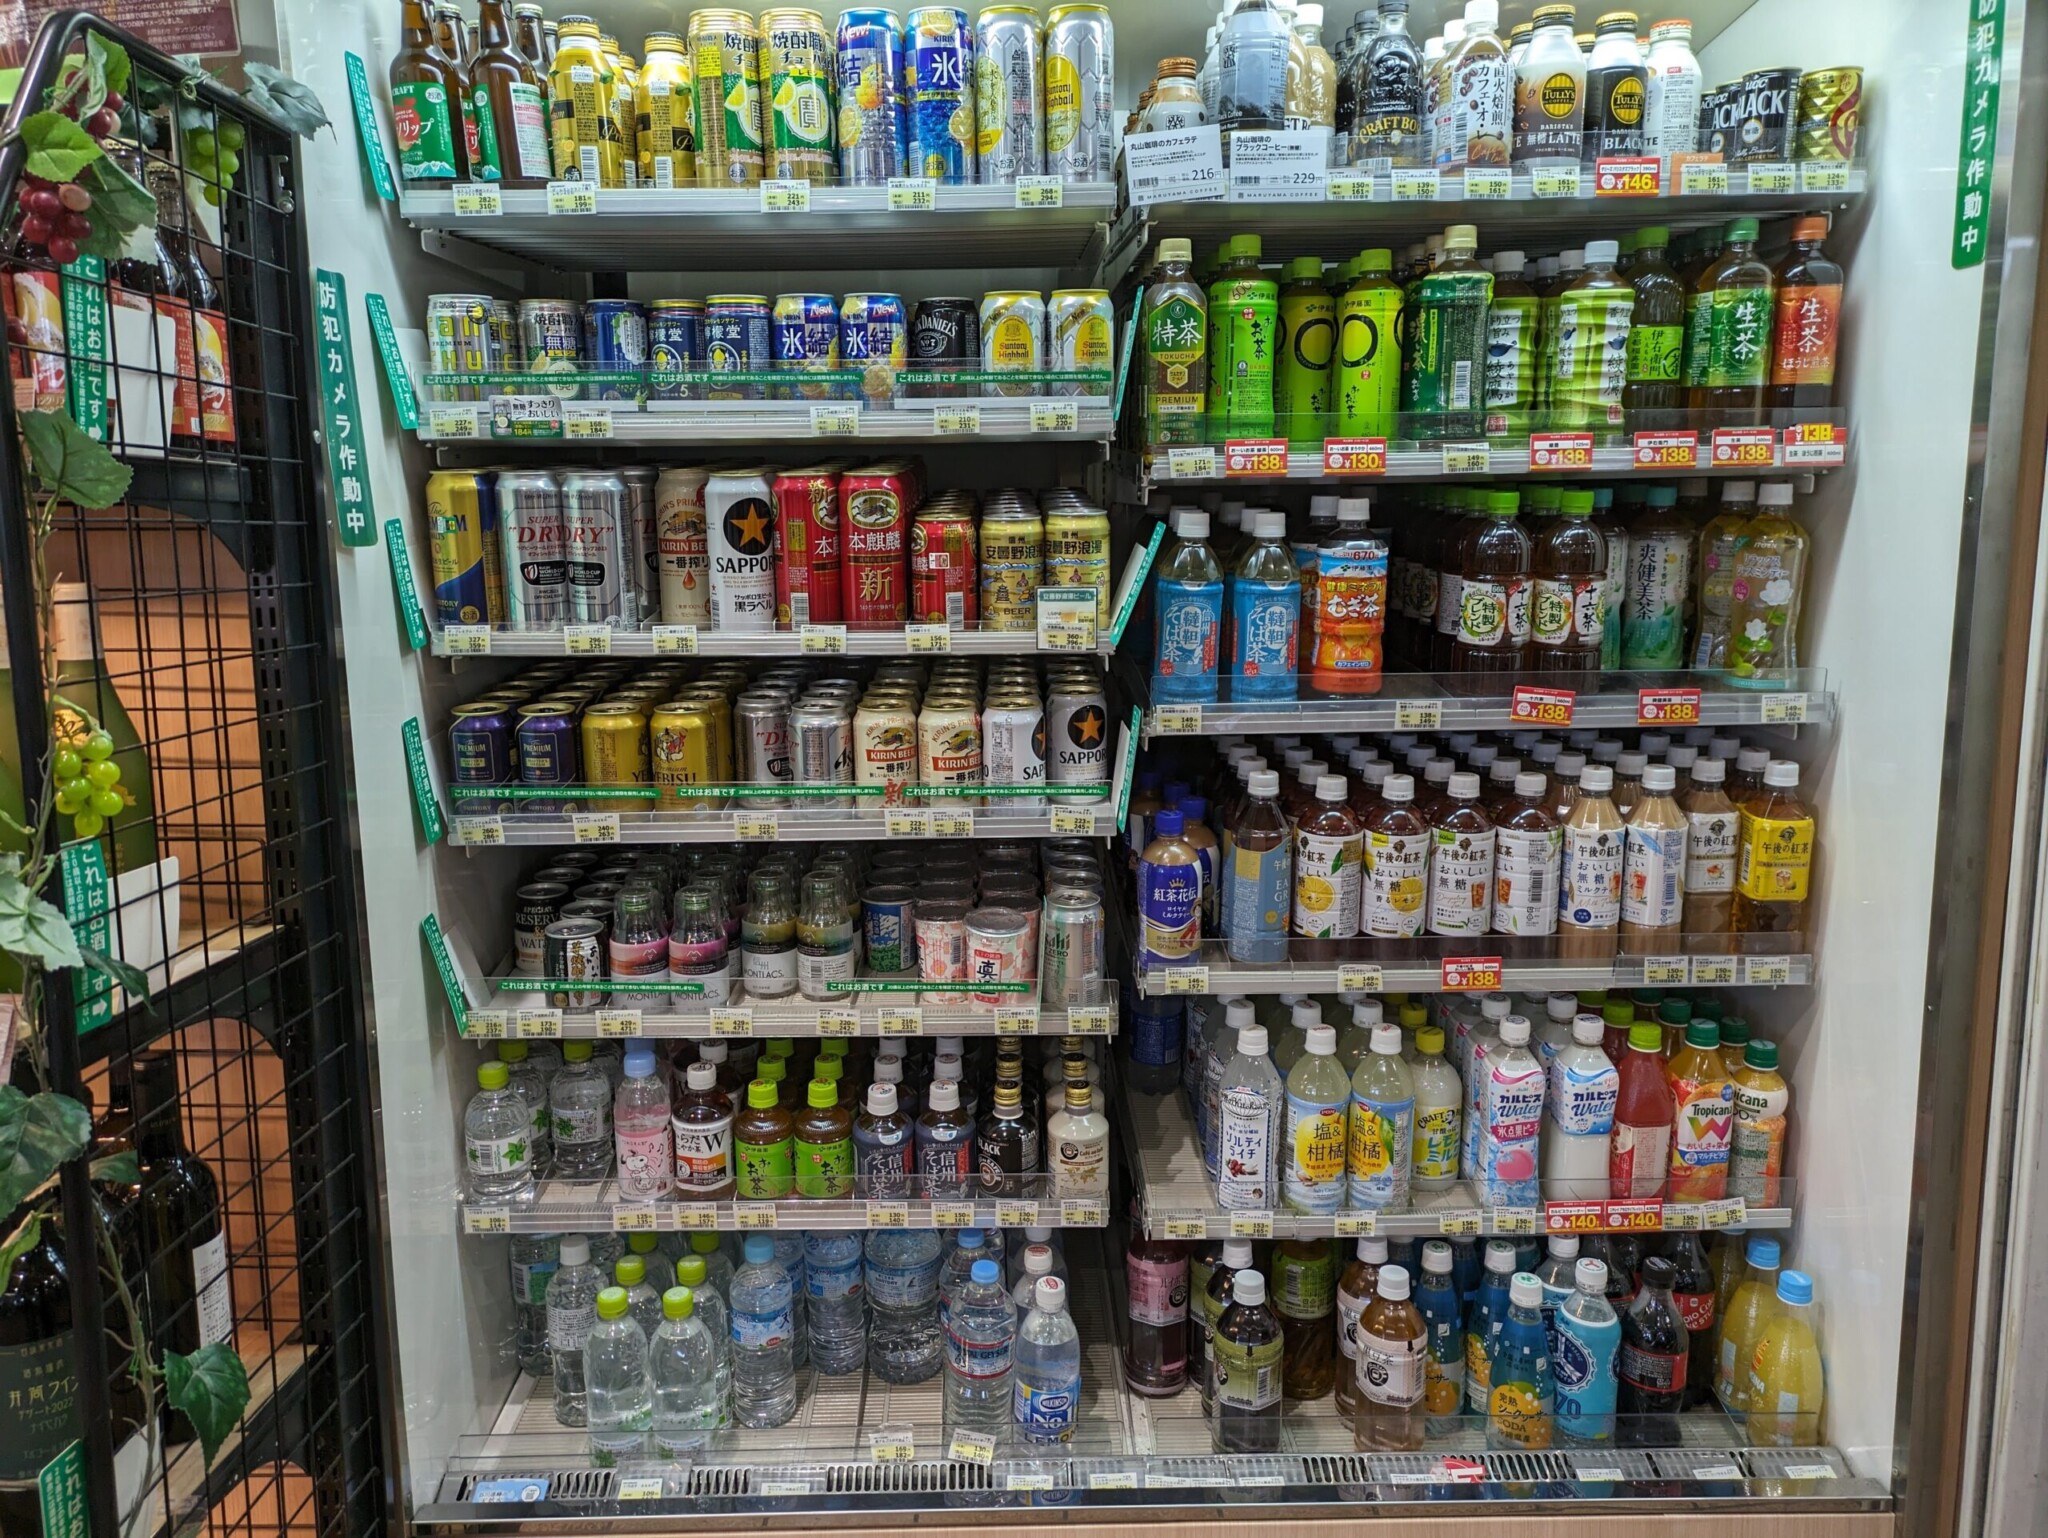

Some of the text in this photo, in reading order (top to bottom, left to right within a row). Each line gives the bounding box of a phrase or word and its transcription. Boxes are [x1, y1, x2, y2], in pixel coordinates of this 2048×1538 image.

[842, 22, 870, 38] New!
[1492, 65, 1505, 126] 直火焙煎
[1960, 0, 1996, 253] 防犯カメラ作動中
[1131, 135, 1197, 151] 丸山珈琲のカフェラテ
[1073, 157, 1088, 167] お酒
[729, 168, 746, 178] お酒
[1733, 302, 1760, 359] 生茶
[1798, 299, 1824, 353] 生茶
[1153, 319, 1203, 348] 特茶
[546, 336, 576, 349] 無糖
[782, 330, 830, 357] 氷結
[846, 330, 892, 356] 氷結
[1651, 330, 1664, 375] 伊右衛門
[1781, 358, 1831, 369] ほうじ煎茶
[427, 375, 485, 383] これはお酒です
[899, 374, 957, 382] これはお酒です
[1486, 360, 1503, 401] 綾鷹
[528, 400, 555, 408] すっきり
[1156, 396, 1199, 404] PREMIUM
[319, 282, 365, 534] 防犯カメラ作動中
[528, 410, 559, 418] おいしい
[566, 517, 593, 525] SUPER
[661, 541, 689, 552] KIRIN
[848, 532, 900, 551] 本麒麟
[1008, 536, 1025, 544] 信州
[859, 568, 892, 601] 新
[1326, 581, 1383, 592] 健康ミネラル
[1636, 544, 1656, 621] 爽健美茶
[734, 601, 773, 613] 黒ラベル
[1328, 593, 1380, 619] むぎ茶
[1470, 597, 1485, 629] ブレンド
[1514, 585, 1529, 632] 十六茶
[461, 610, 478, 621] お酒
[1481, 602, 1497, 625] 特製
[1163, 603, 1182, 662] そば茶
[457, 744, 486, 752] PREMIUM
[870, 751, 896, 759] KIRIN
[454, 789, 511, 797] これはお酒です
[1442, 849, 1487, 861] 午後の紅茶
[1762, 842, 1808, 854] 午後の紅茶
[1376, 851, 1421, 863] 午後の紅茶
[1374, 867, 1422, 877] おいしい
[1153, 888, 1196, 900] 紅茶花伝
[830, 983, 884, 991] これはお酒です
[1574, 1090, 1617, 1102] カルピス
[1572, 1101, 1615, 1116] Water
[1691, 1104, 1733, 1116] Tropicana
[702, 1130, 724, 1152] W
[1307, 1143, 1344, 1161] 柑橘
[926, 1150, 942, 1197] そば茶
[940, 1151, 955, 1182] 信州
[1499, 1393, 1518, 1407] 完熟
[1024, 1429, 1075, 1445] LEMON
